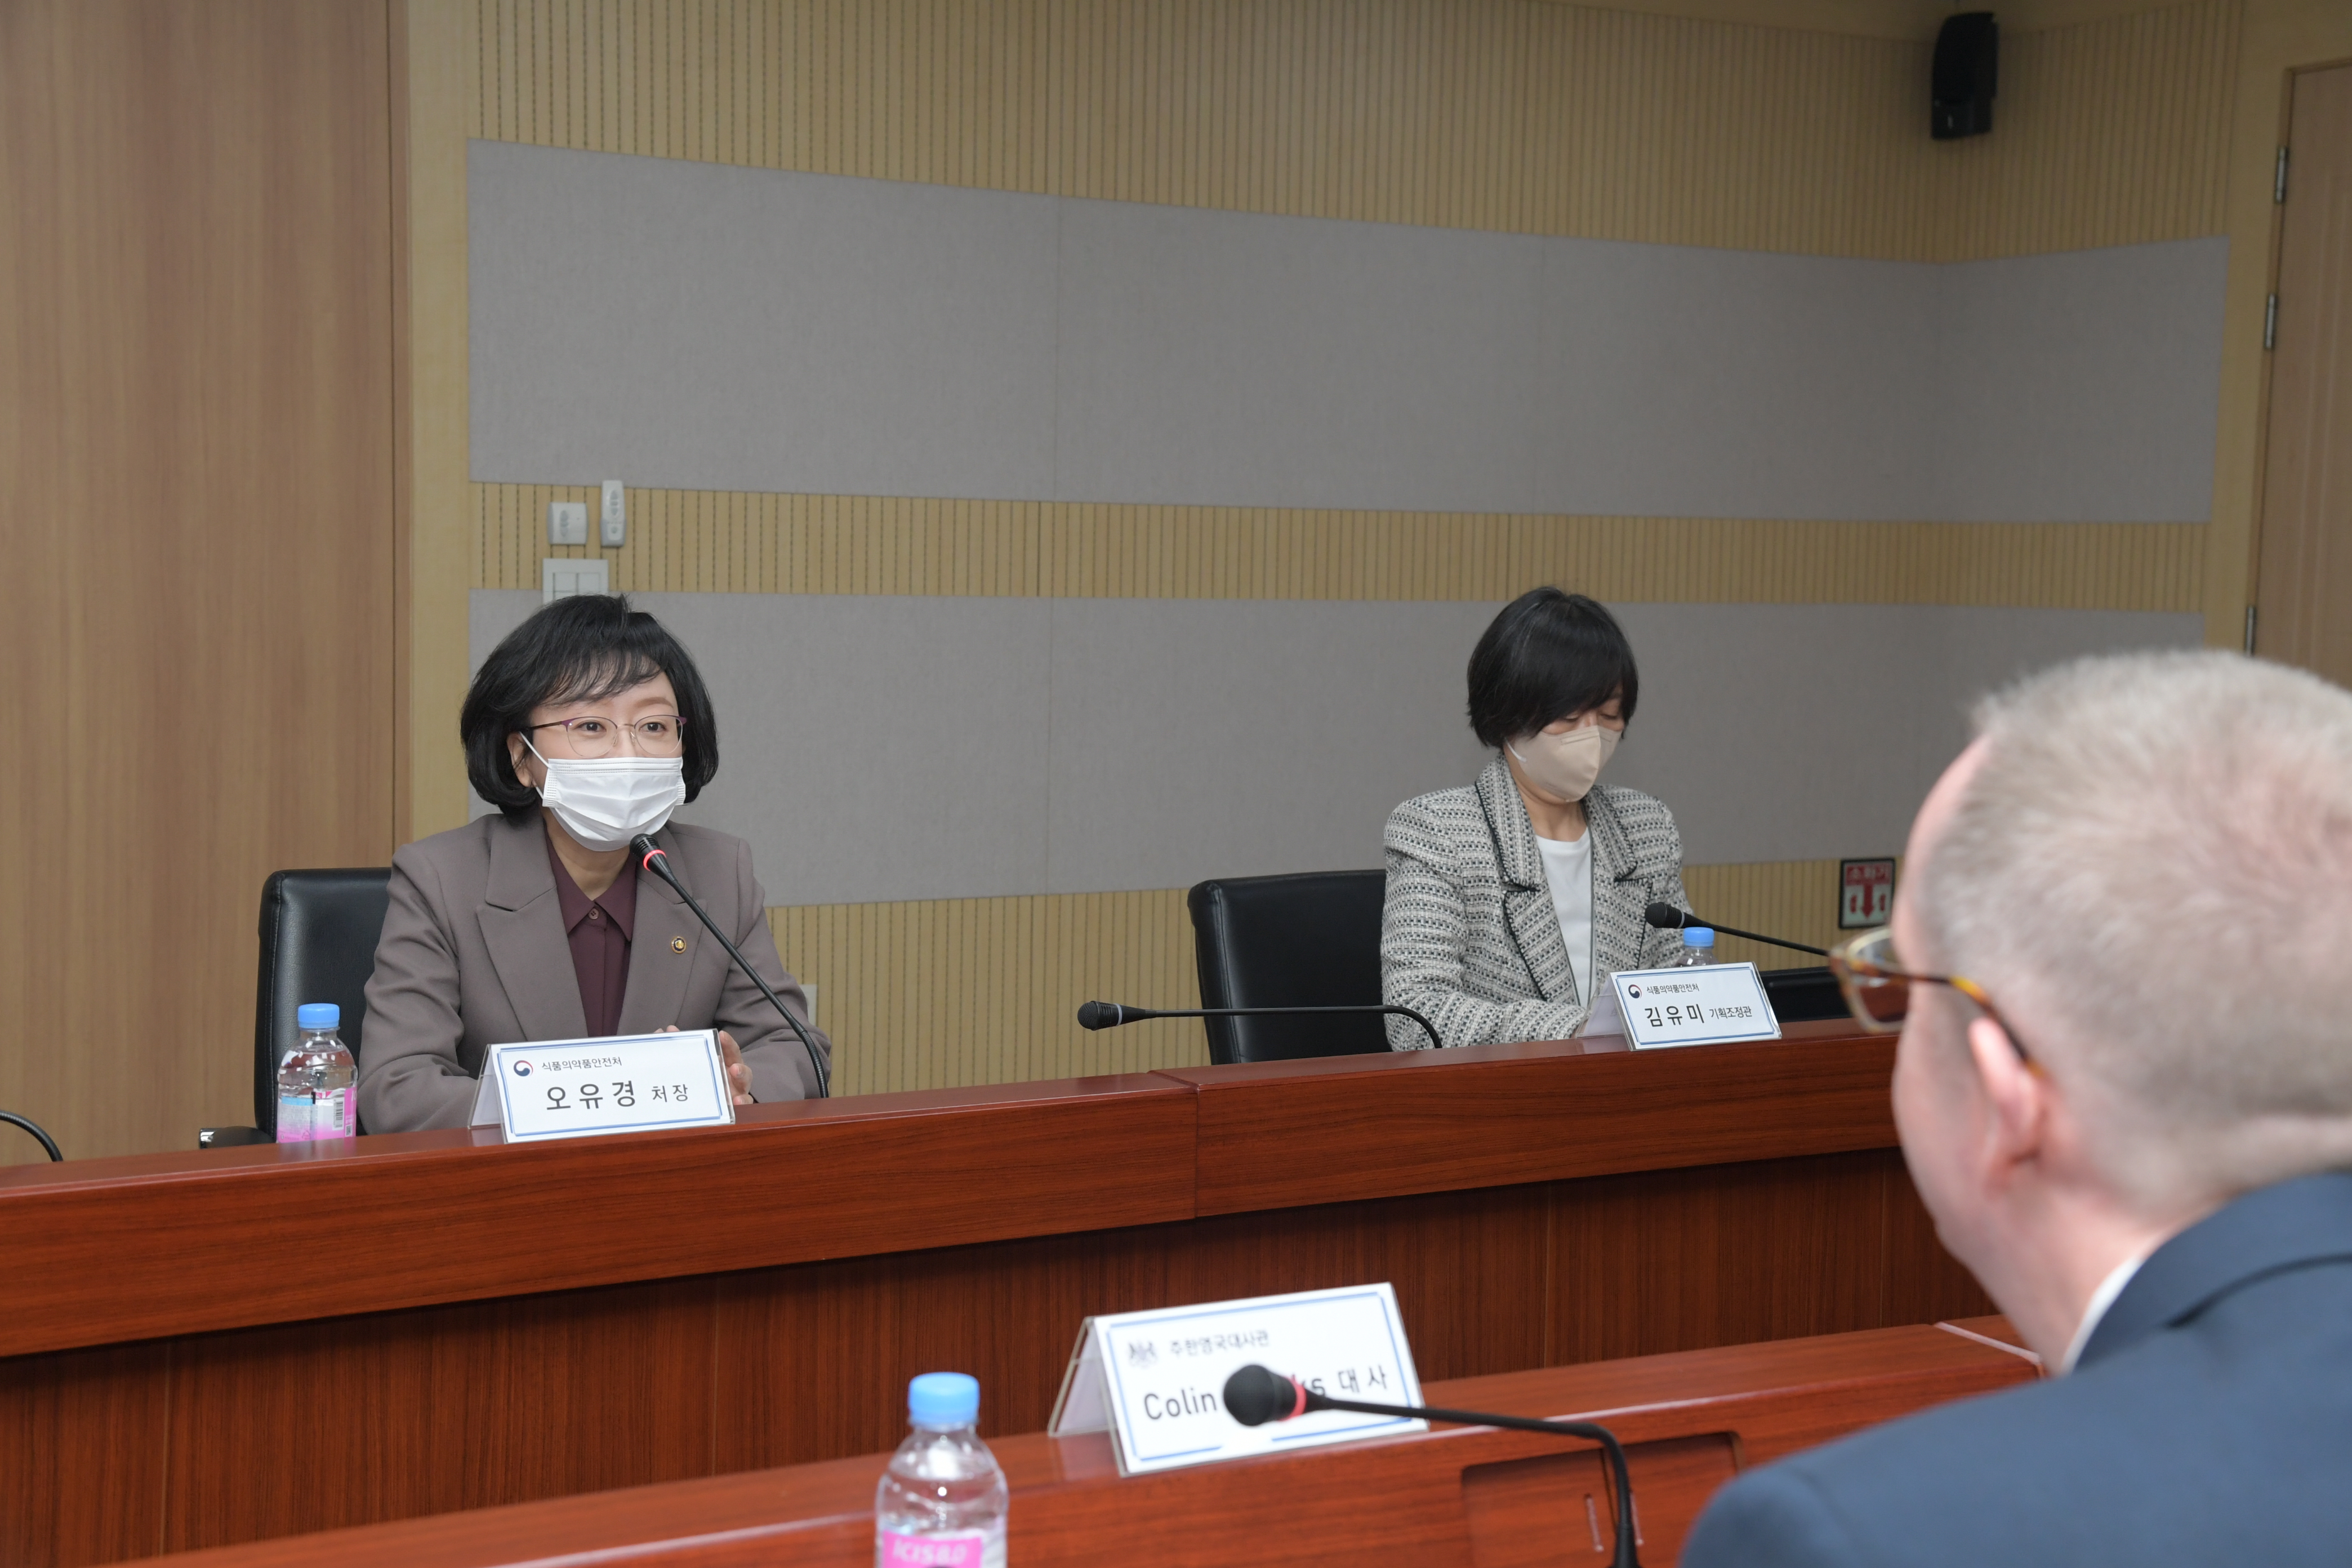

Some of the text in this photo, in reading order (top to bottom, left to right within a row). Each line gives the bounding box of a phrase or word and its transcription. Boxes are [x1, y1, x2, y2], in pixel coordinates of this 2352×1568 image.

[1646, 983, 1700, 995] 식품의약품안전처
[1645, 1004, 1753, 1027] 김유미 기획조정관
[541, 1056, 622, 1072] 식품의약품안전처
[546, 1080, 689, 1111] 오유경 처장
[1144, 1388, 1218, 1421] Colin
[1337, 1364, 1388, 1393] 대사
